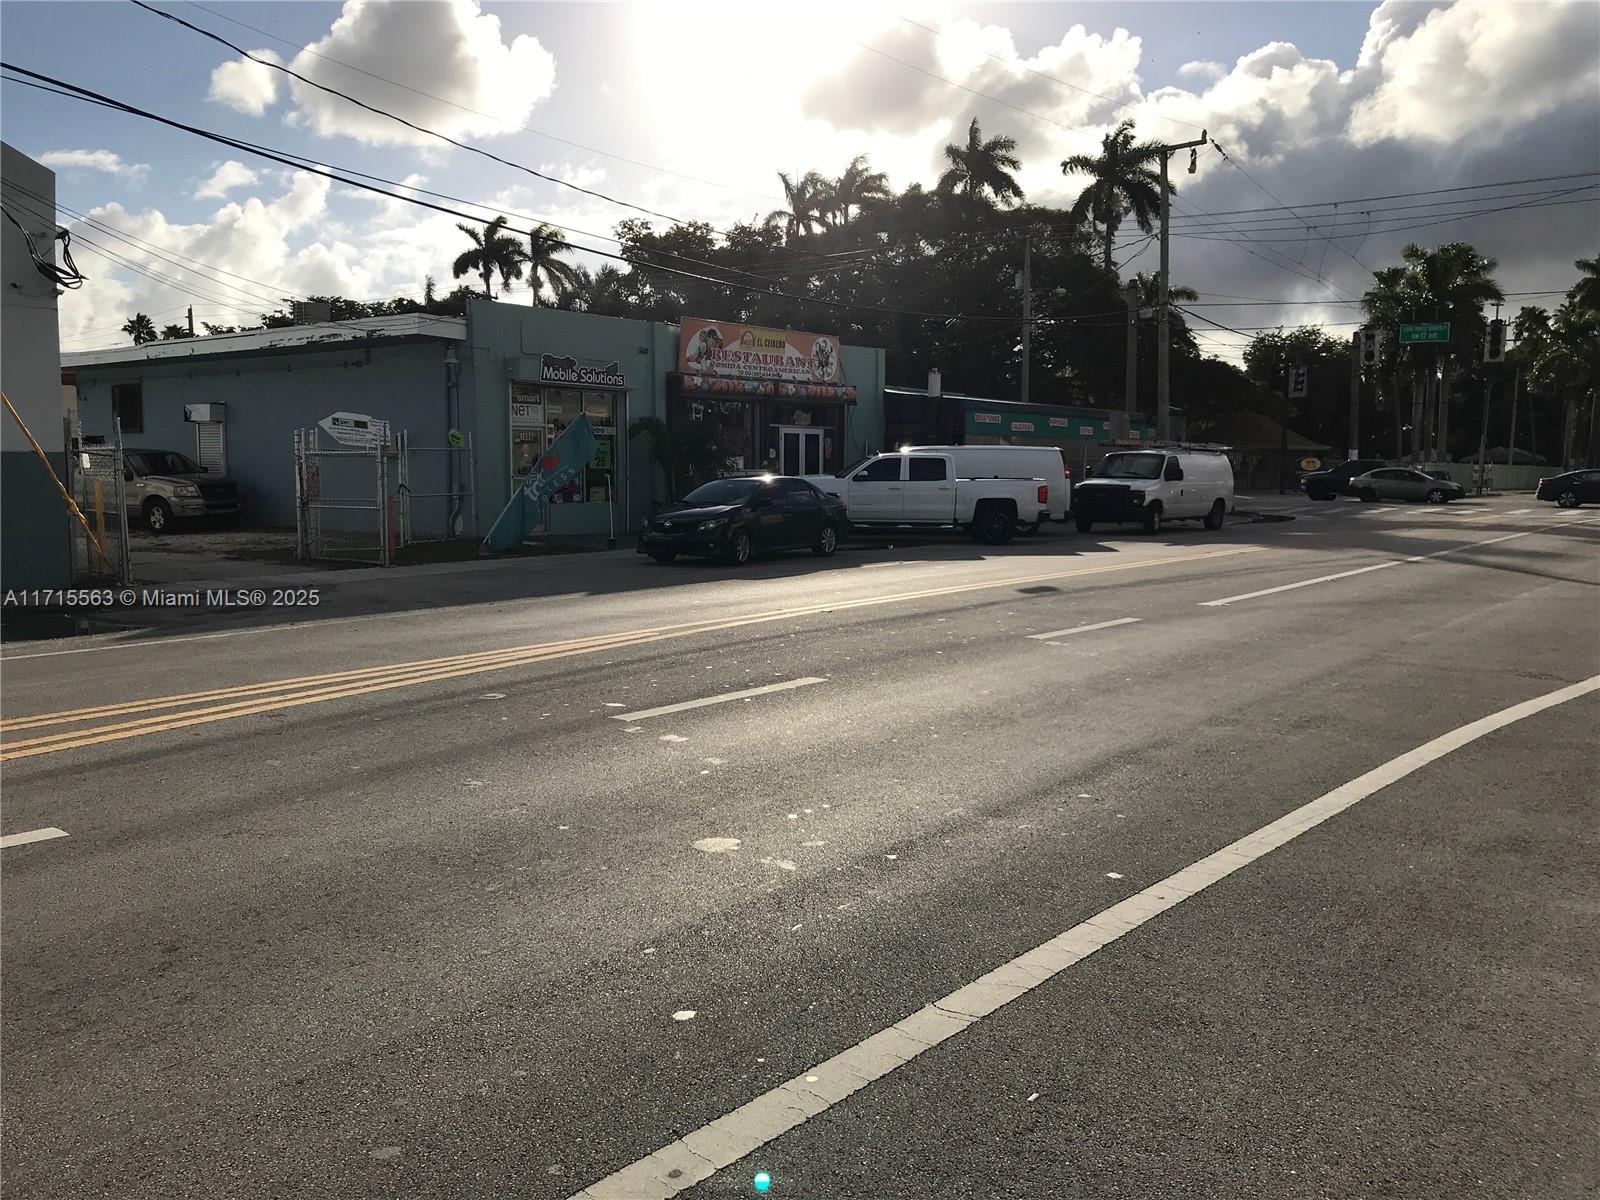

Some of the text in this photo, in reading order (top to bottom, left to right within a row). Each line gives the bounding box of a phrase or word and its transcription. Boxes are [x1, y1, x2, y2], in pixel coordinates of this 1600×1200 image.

[710, 361, 741, 369] COMIDA
[711, 347, 817, 369] RESTAURANT
[543, 367, 624, 385] Mobile Solutions
